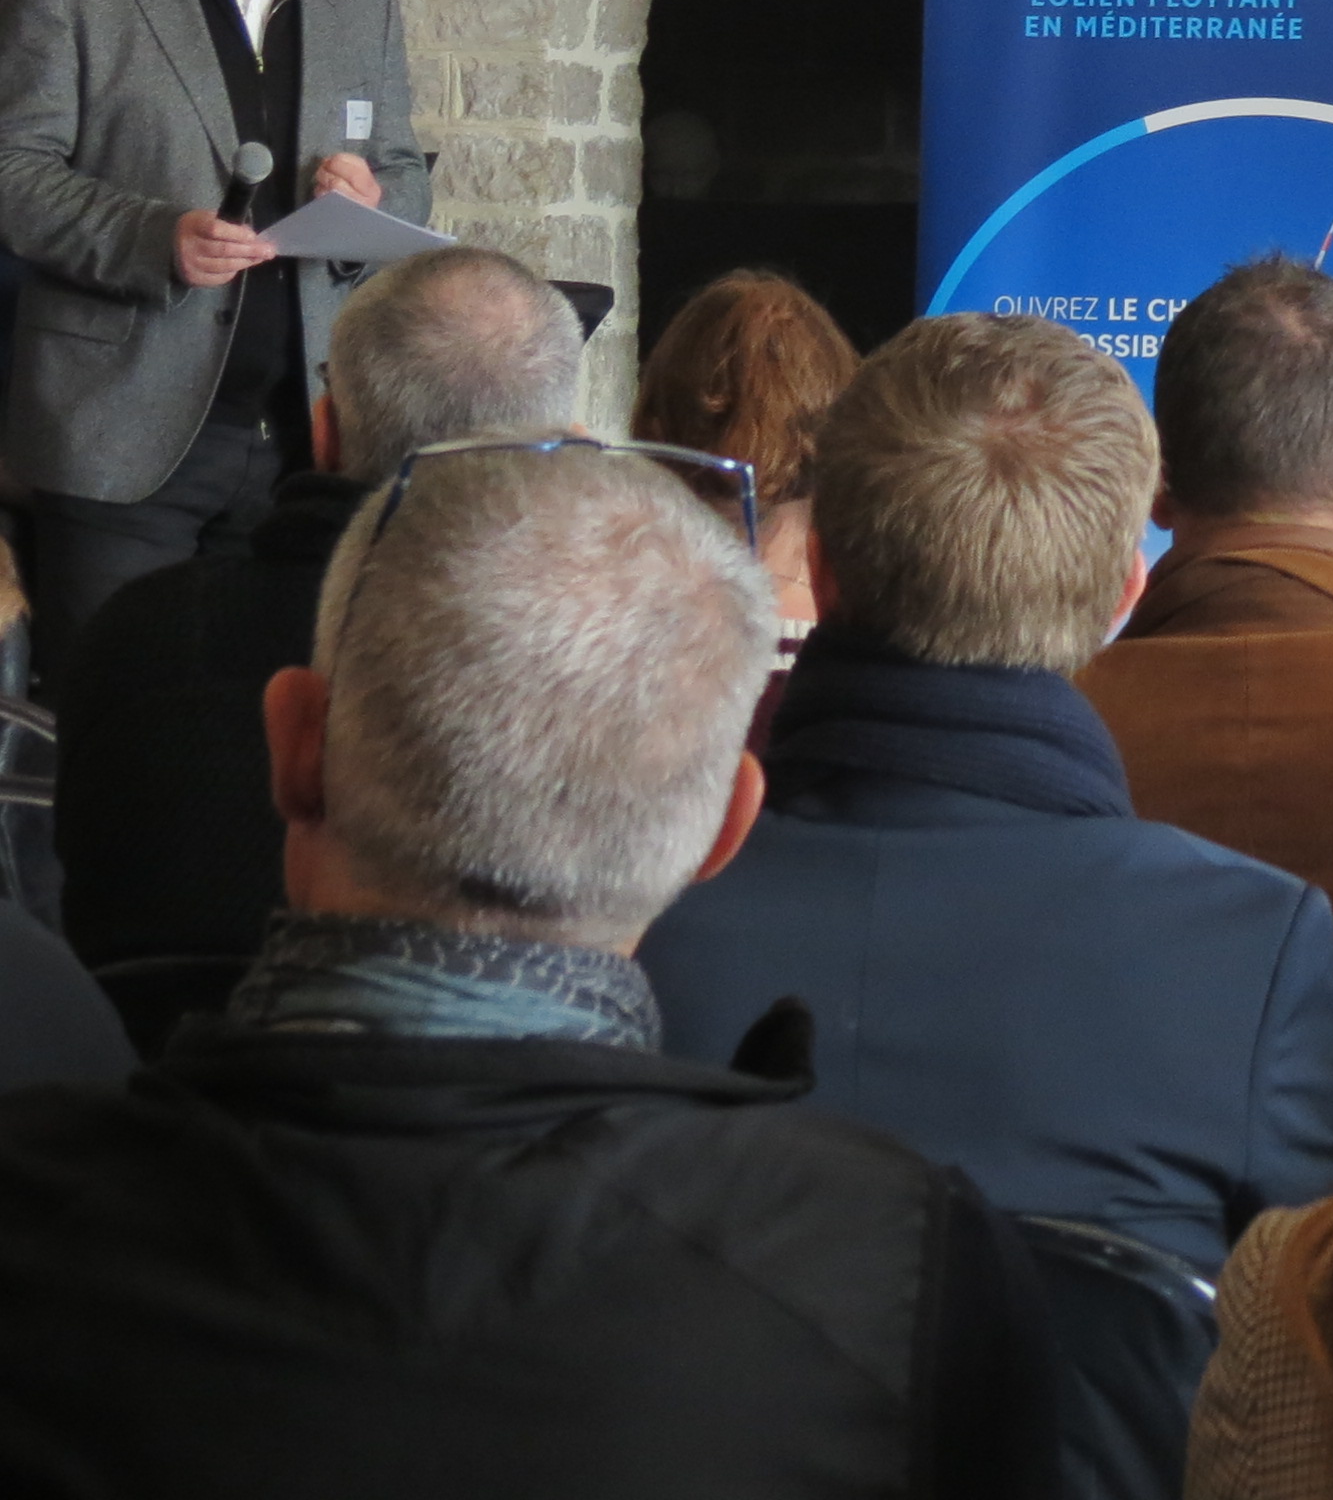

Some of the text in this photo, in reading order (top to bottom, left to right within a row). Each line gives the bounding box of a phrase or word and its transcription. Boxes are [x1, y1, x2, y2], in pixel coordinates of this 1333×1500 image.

[1025, 9, 1303, 41] EN MÉDITERRANÉE
[994, 295, 1099, 320] OUVREZ
[1108, 297, 1138, 321] LE
